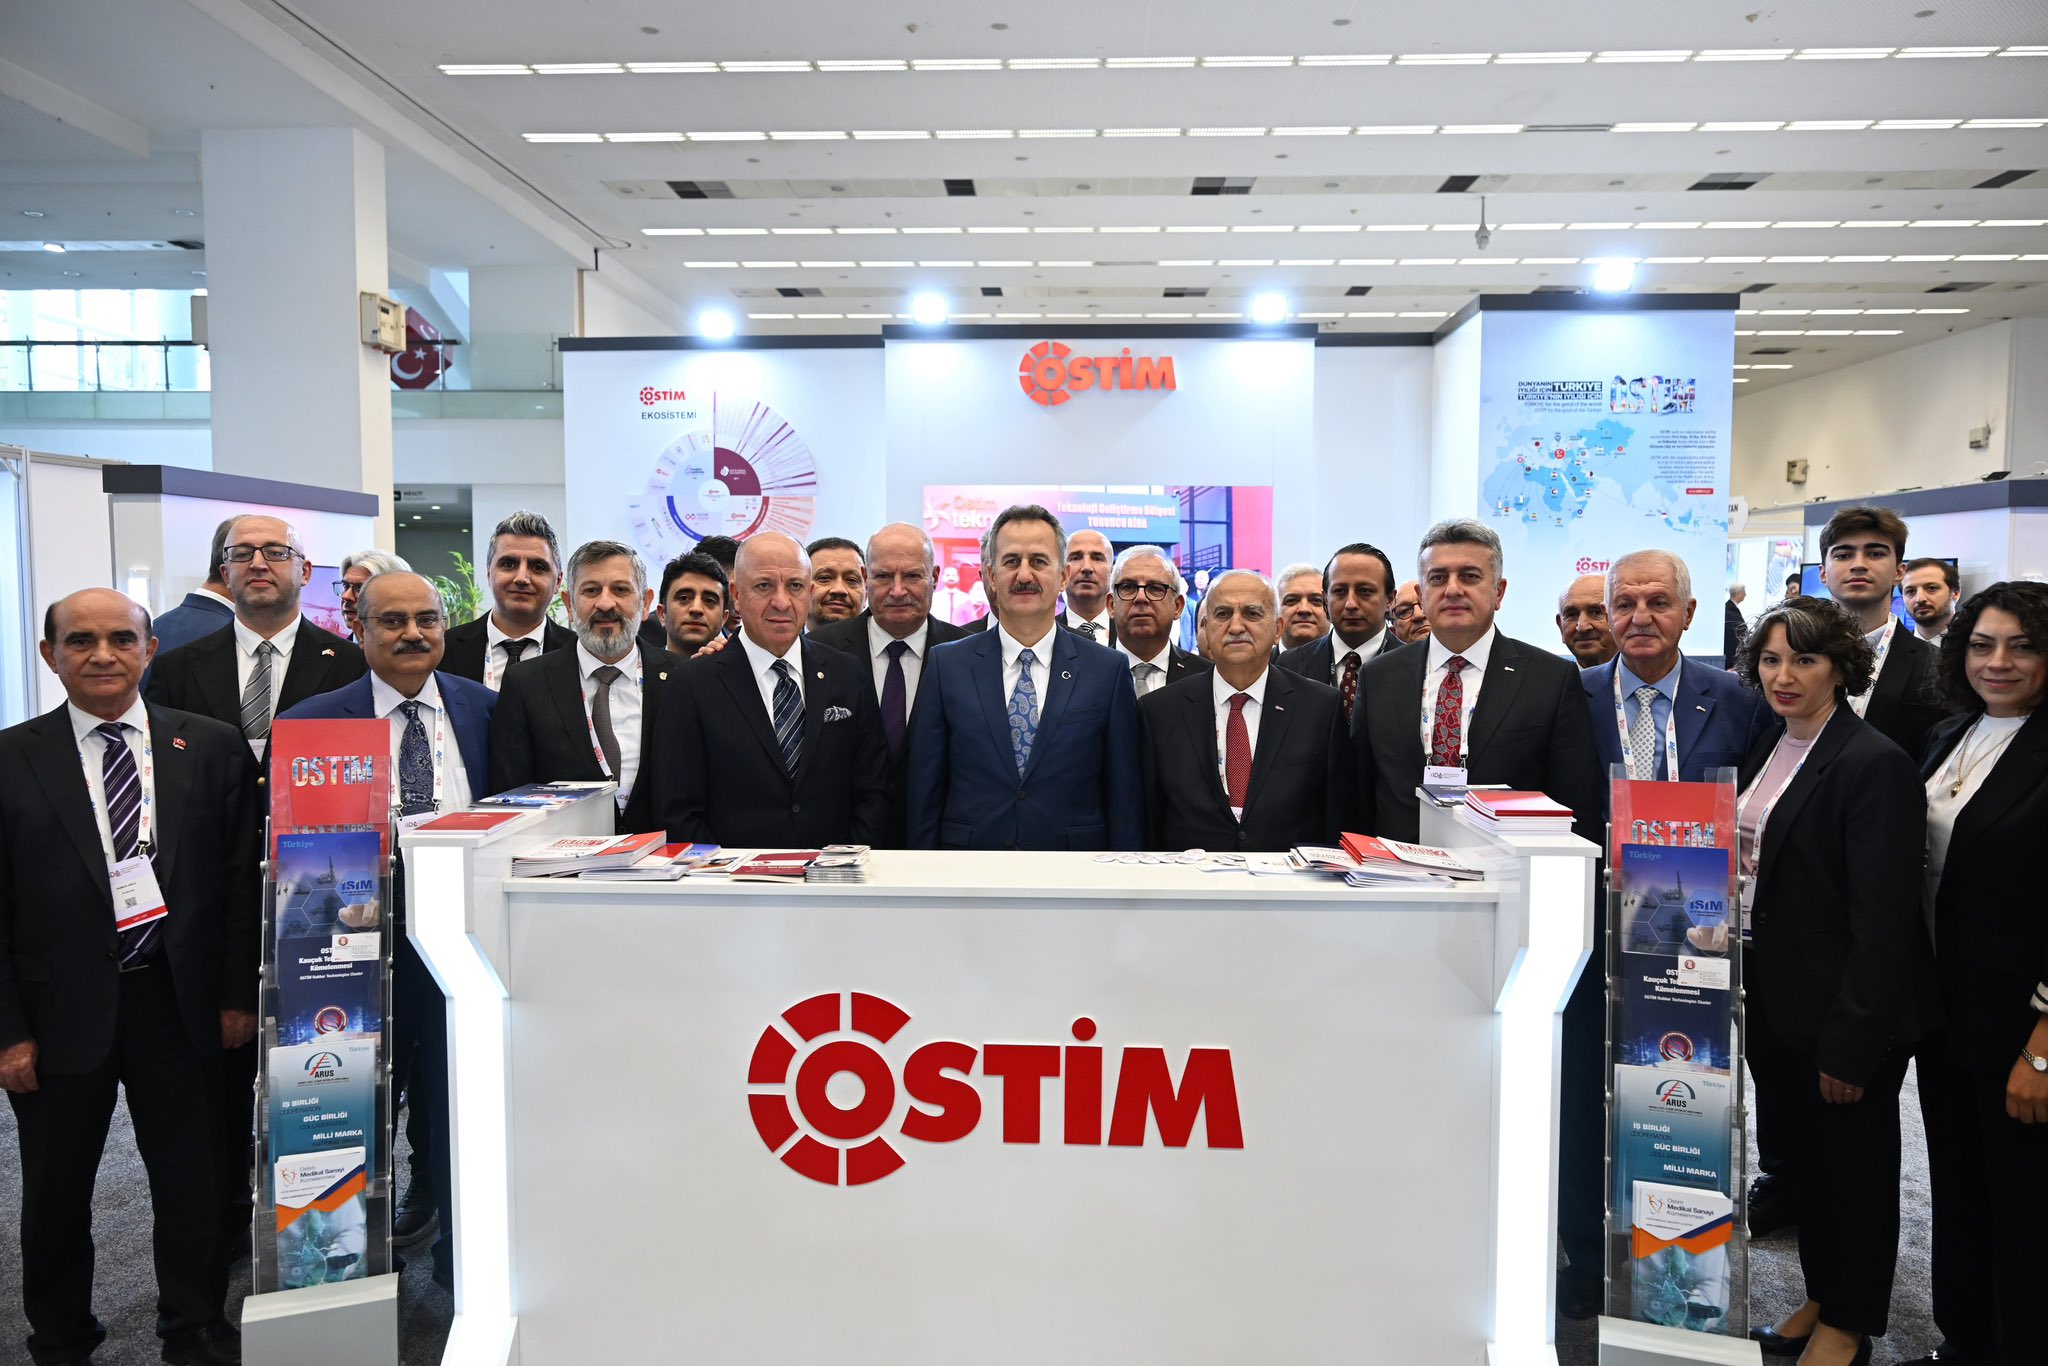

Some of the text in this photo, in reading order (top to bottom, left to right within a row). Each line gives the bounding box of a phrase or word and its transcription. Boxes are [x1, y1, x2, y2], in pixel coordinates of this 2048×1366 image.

[644, 388, 686, 401] OSTİM
[641, 410, 697, 420] EKOSİSTEMİ
[952, 510, 993, 529] tekn
[1581, 559, 1610, 571] OSTİ
[282, 841, 315, 849] Türkiye
[1629, 851, 1661, 860] Türkiye
[1666, 968, 1679, 976] OST
[314, 1070, 335, 1078] ARUS
[1665, 1098, 1687, 1108] ARUS
[335, 1129, 363, 1138] MARKA
[300, 1167, 345, 1178] Medikal Sanayi
[1686, 1167, 1717, 1178] MARKA
[1667, 1204, 1714, 1216] Medikal Sanayi
